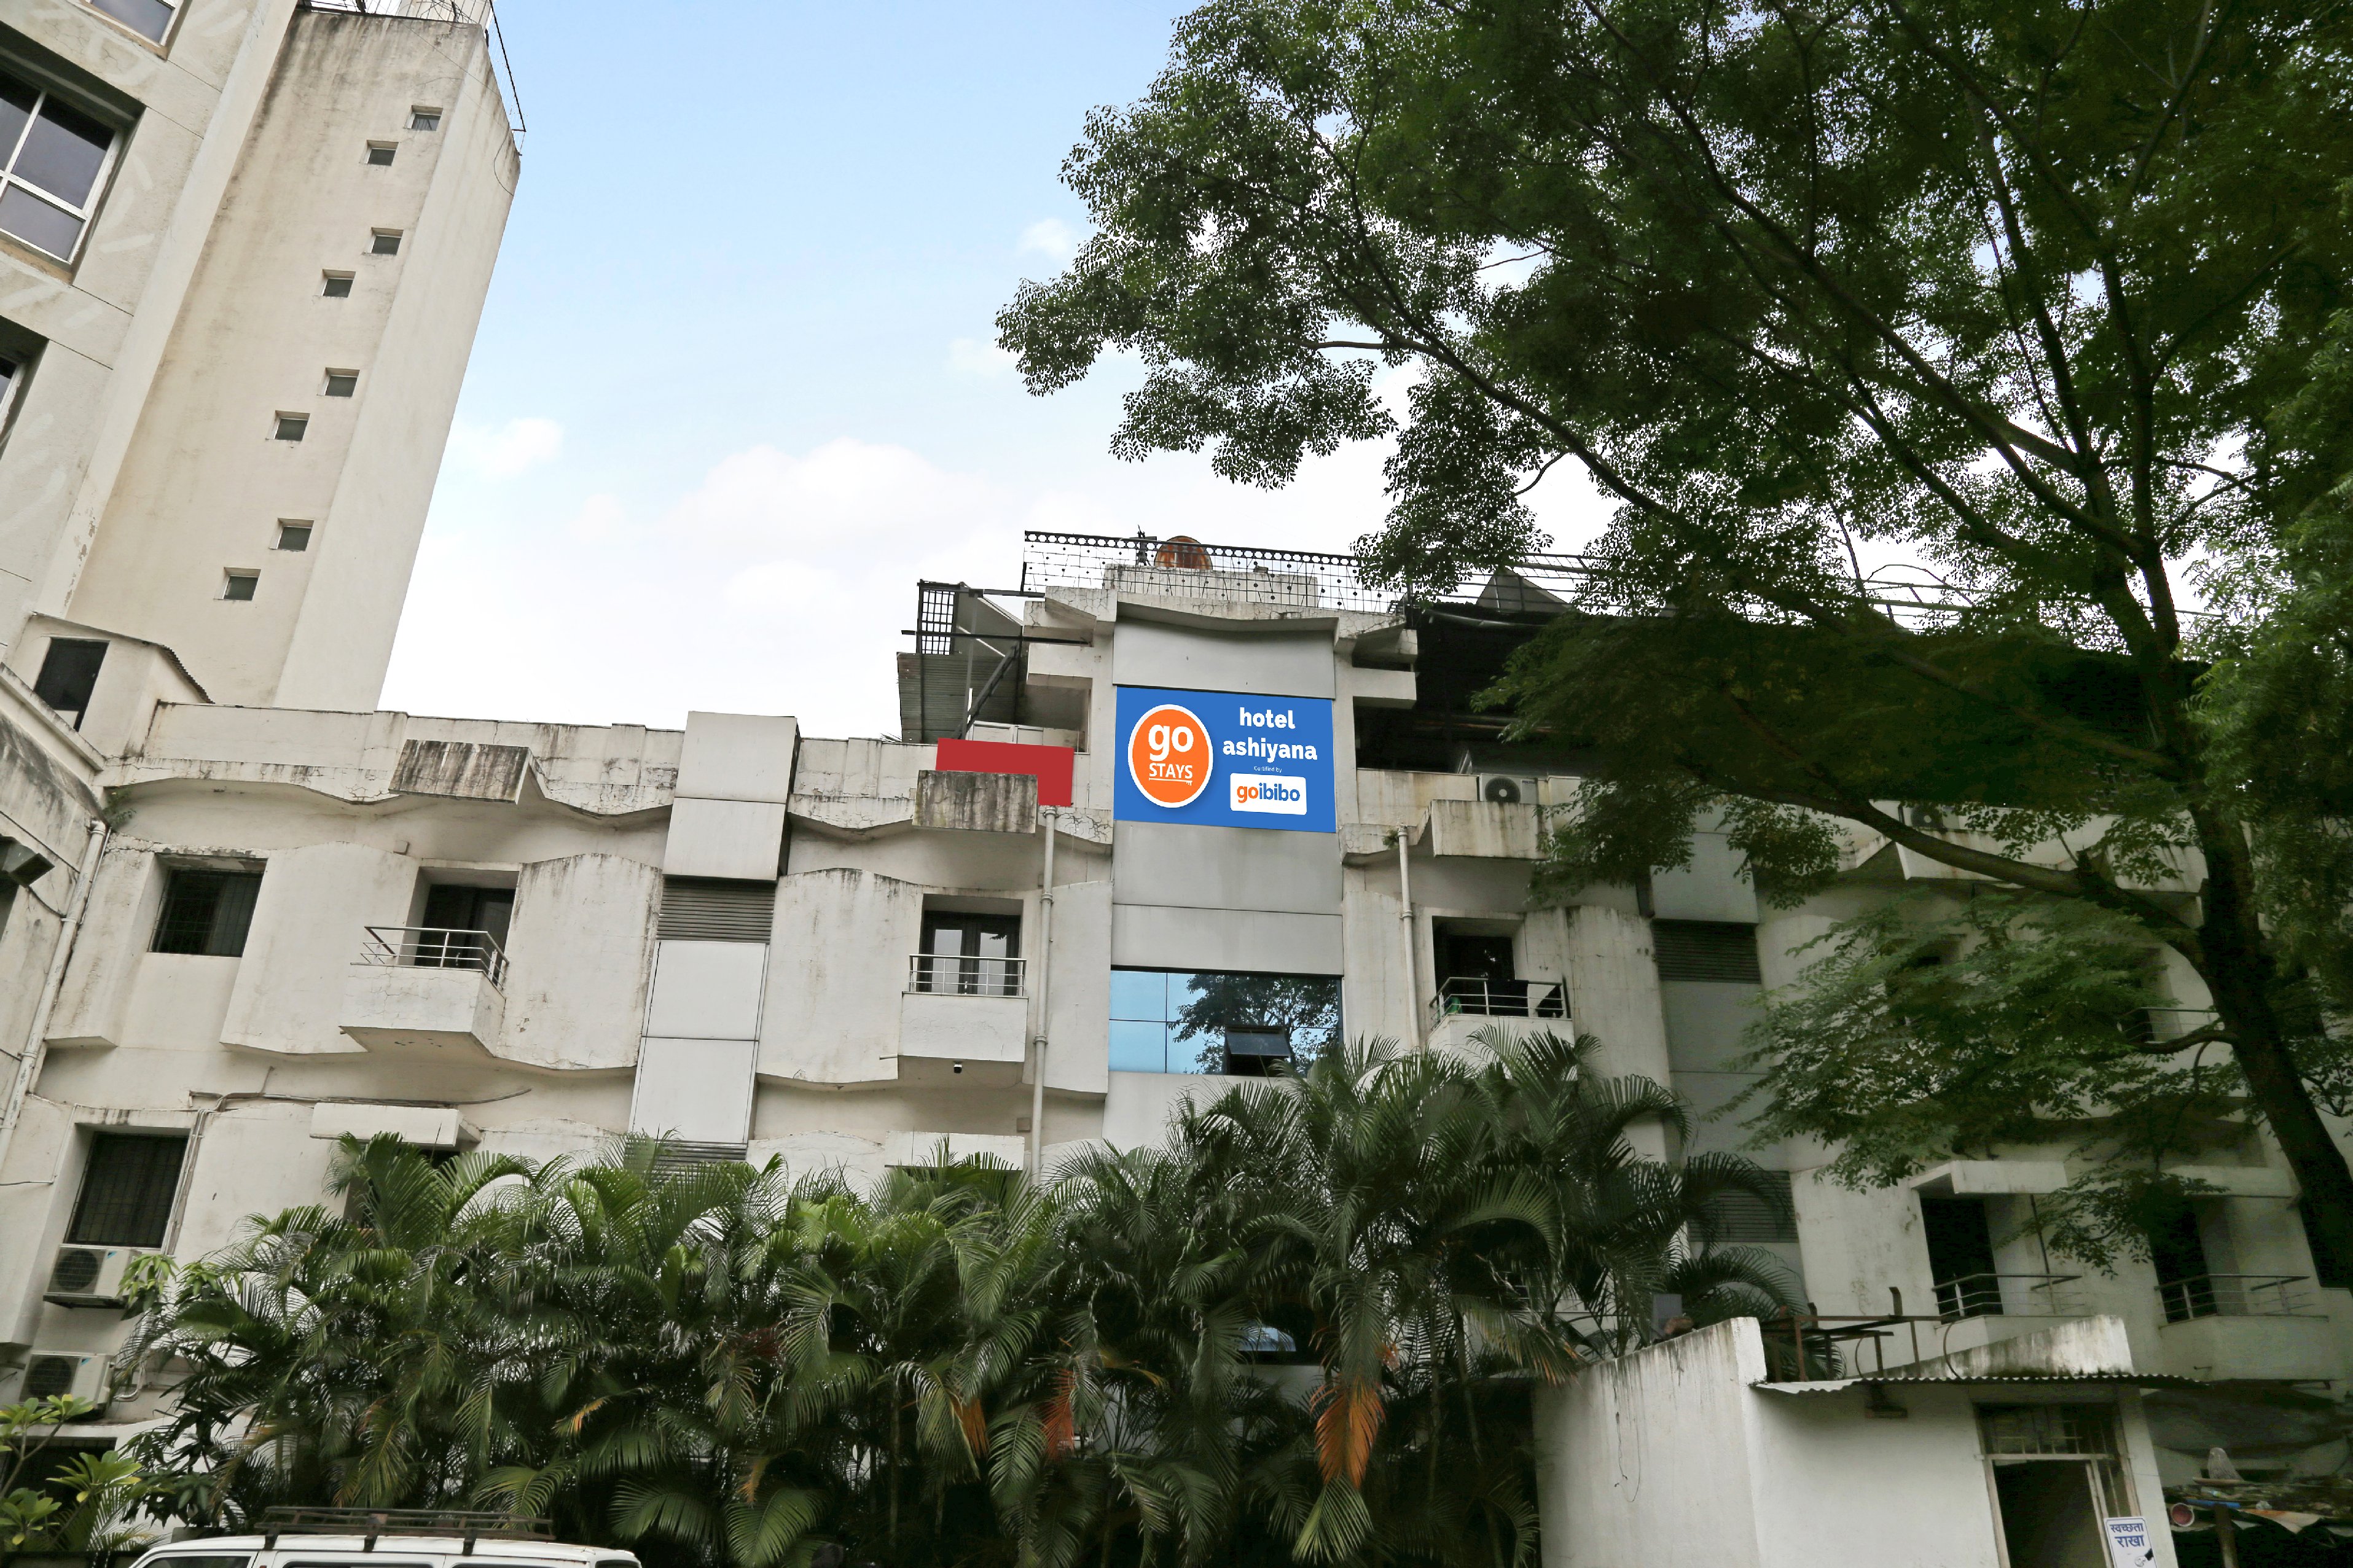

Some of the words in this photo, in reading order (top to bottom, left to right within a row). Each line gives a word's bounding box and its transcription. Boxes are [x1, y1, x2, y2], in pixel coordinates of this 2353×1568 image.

[1240, 707, 1296, 729] hotel
[1148, 724, 1194, 762] go
[1223, 737, 1317, 763] ashiyana
[1149, 762, 1193, 779] STAYS
[1237, 782, 1300, 803] goibibo
[2109, 1523, 2144, 1533] स्वच्छता
[2114, 1535, 2145, 1548] राखा
